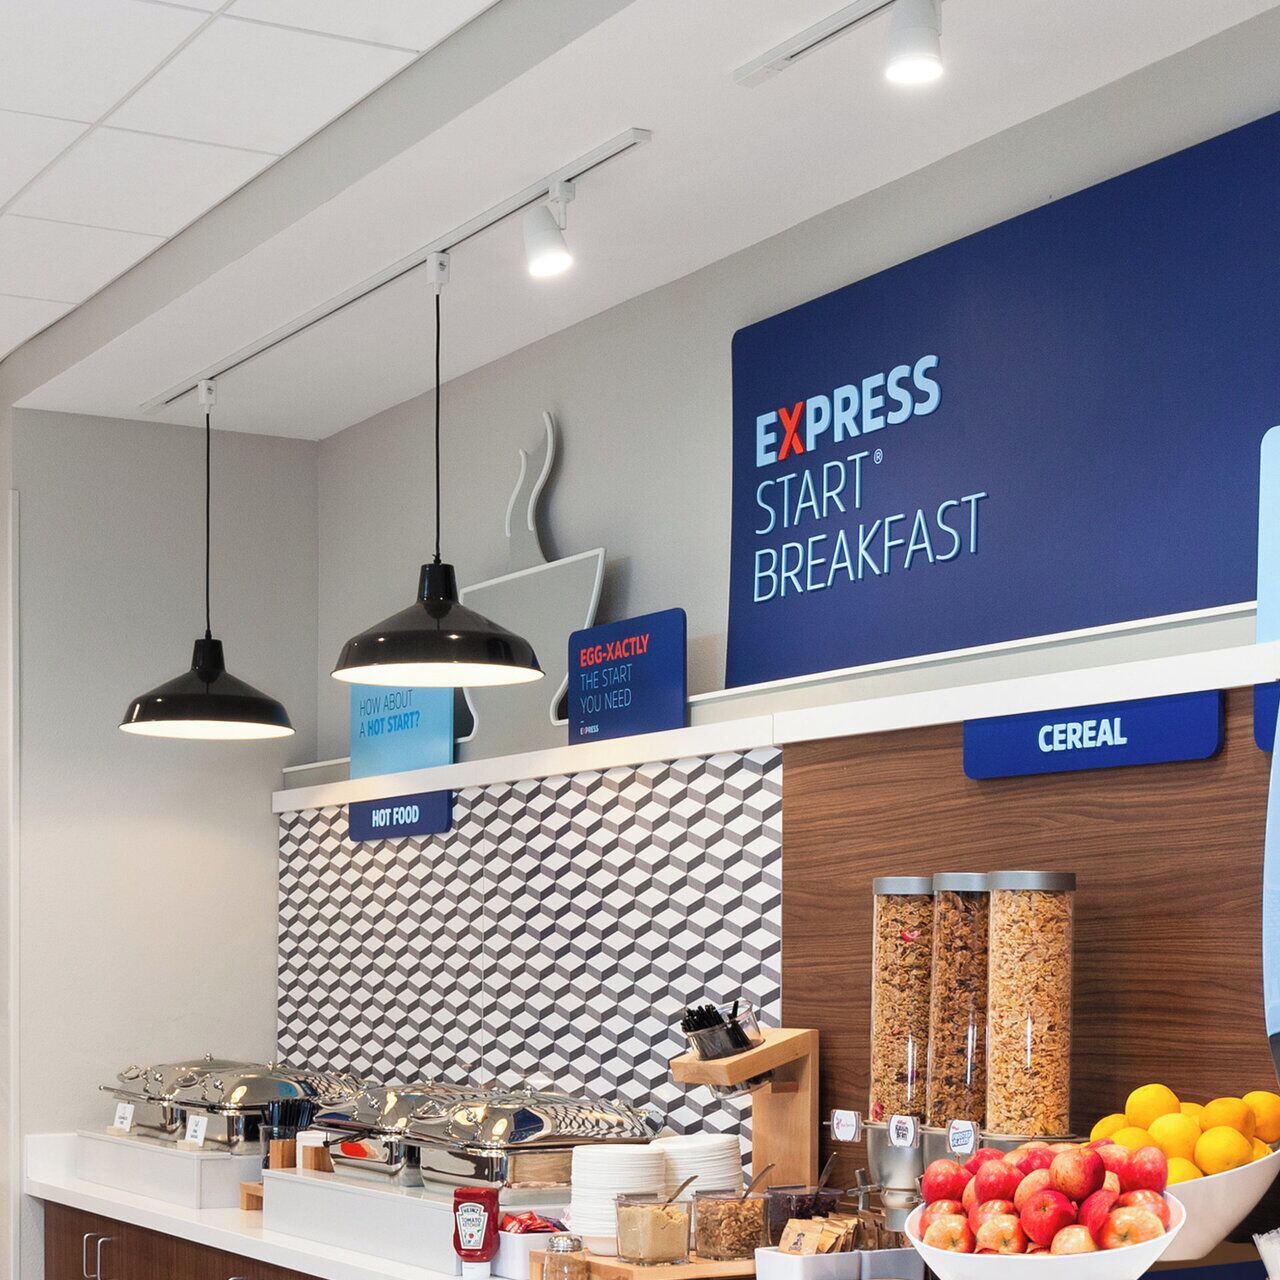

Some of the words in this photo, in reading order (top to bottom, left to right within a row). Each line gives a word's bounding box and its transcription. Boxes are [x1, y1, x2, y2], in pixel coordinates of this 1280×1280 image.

[755, 354, 942, 468] EXPRESS
[753, 491, 988, 602] BREAKFAST
[580, 633, 649, 668] EGG-XACTLY
[580, 670, 599, 691] THE
[602, 663, 633, 688] START
[359, 696, 381, 716] HOW
[383, 689, 414, 713] ABOUT
[580, 694, 602, 714] YOU
[604, 688, 632, 710] NEED
[359, 721, 366, 738] A
[367, 716, 387, 737] HOT
[387, 710, 421, 734] START?
[1037, 717, 1128, 753] CEREAL
[371, 808, 391, 828] HOT
[392, 804, 420, 826] FOOD
